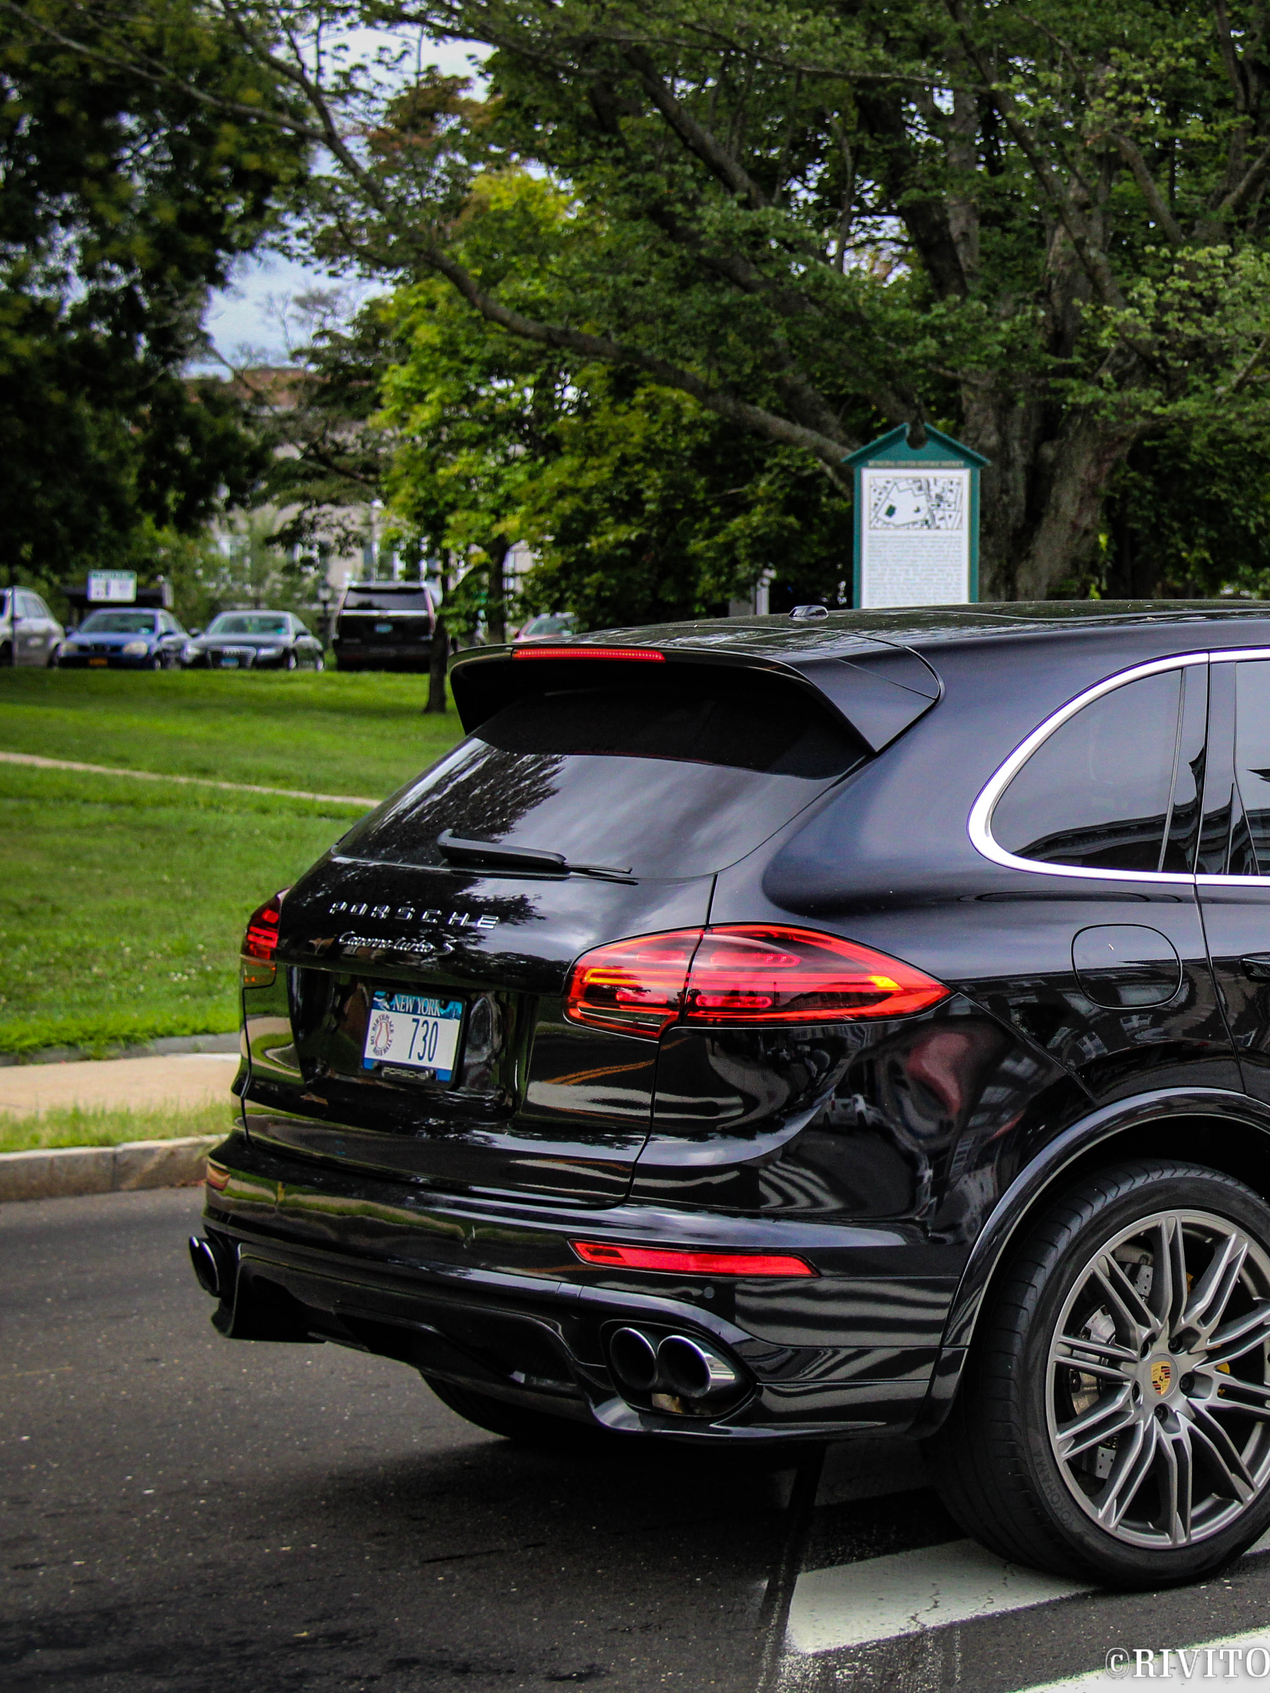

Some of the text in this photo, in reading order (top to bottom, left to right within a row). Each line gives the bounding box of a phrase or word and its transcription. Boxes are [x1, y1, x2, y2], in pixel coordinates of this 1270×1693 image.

[329, 901, 501, 930] PORSCHE
[392, 994, 441, 1017] NEW YORK
[407, 1017, 440, 1063] 730
